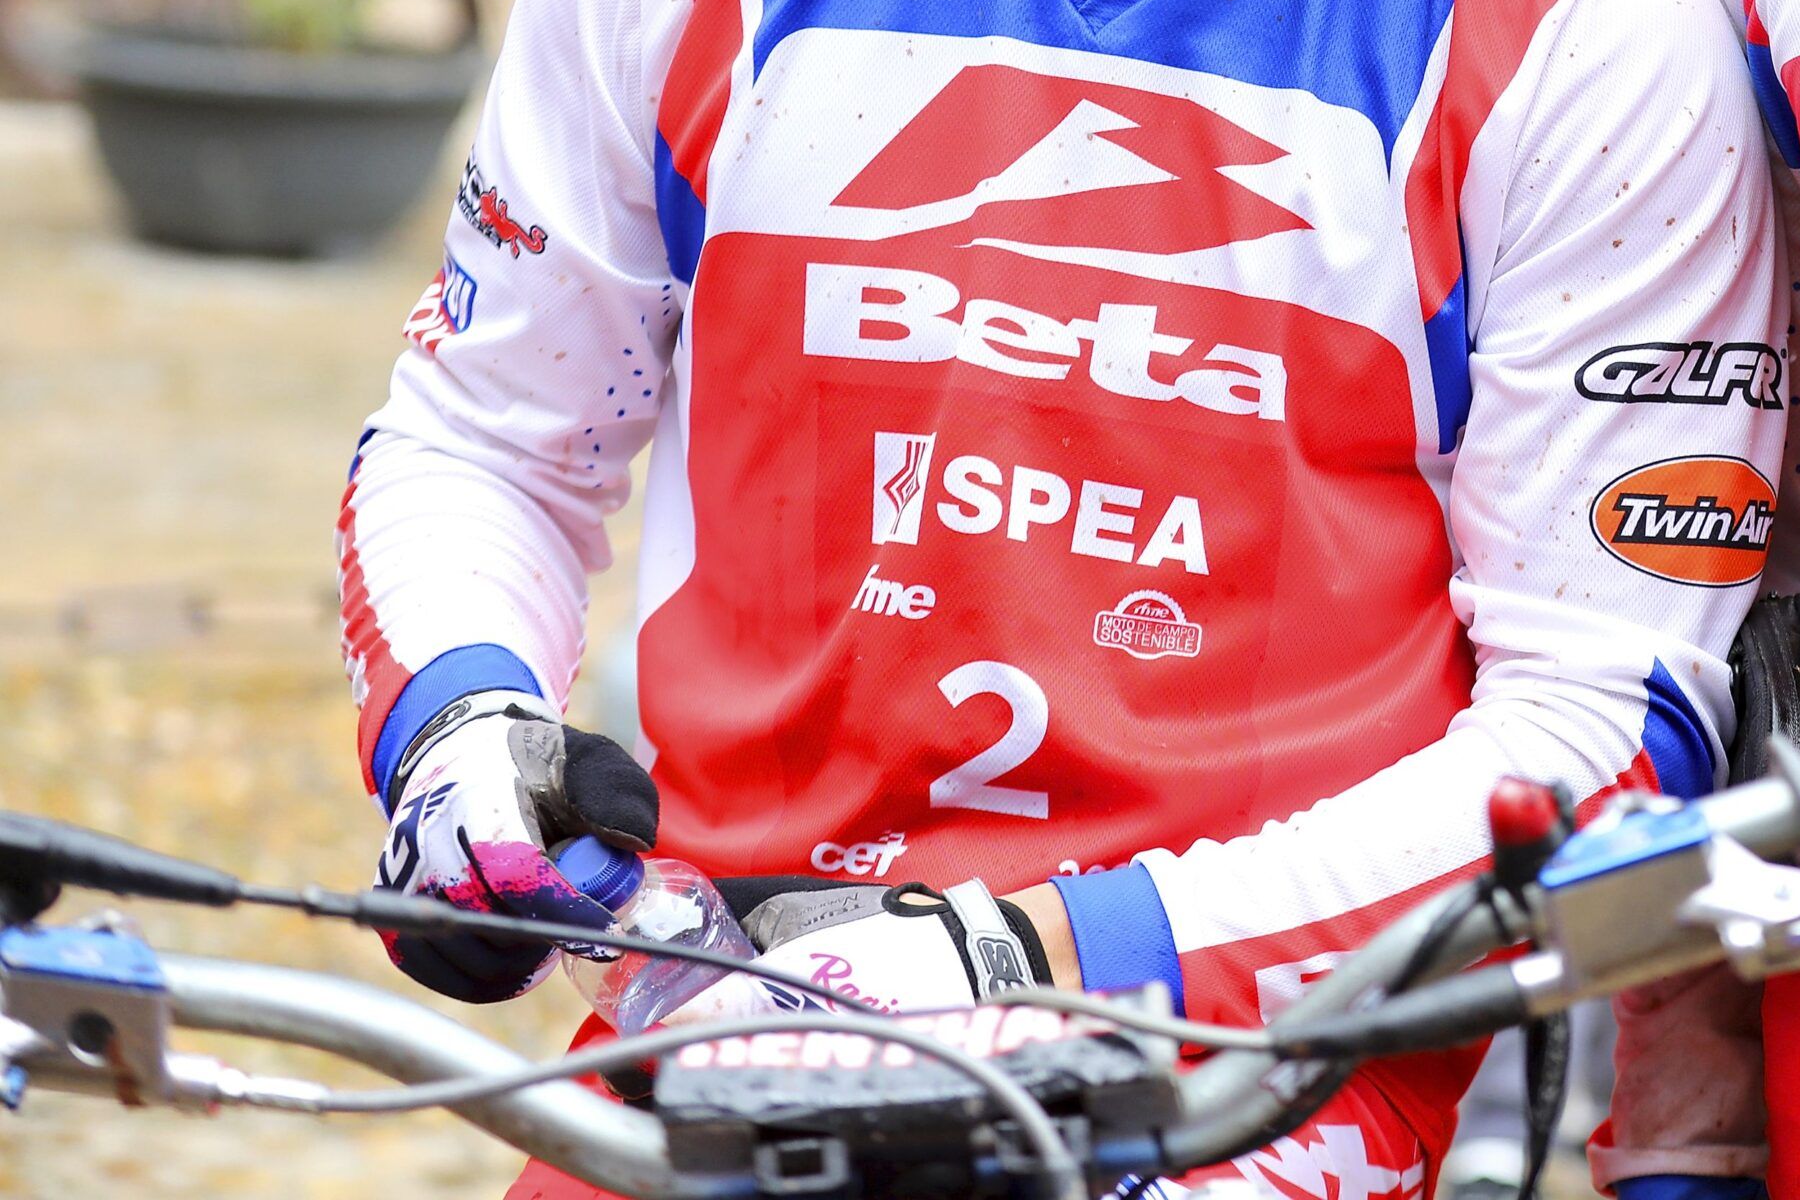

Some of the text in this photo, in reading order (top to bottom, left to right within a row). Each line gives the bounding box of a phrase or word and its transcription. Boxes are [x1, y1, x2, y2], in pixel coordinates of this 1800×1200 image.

[803, 263, 1287, 422] Beta
[936, 455, 1210, 575] SPEA
[1620, 497, 1733, 541] Twin
[1100, 627, 1195, 652] SOSTENIBLE
[1101, 615, 1196, 639] MOTO DE CAMPO
[929, 660, 1049, 820] 2
